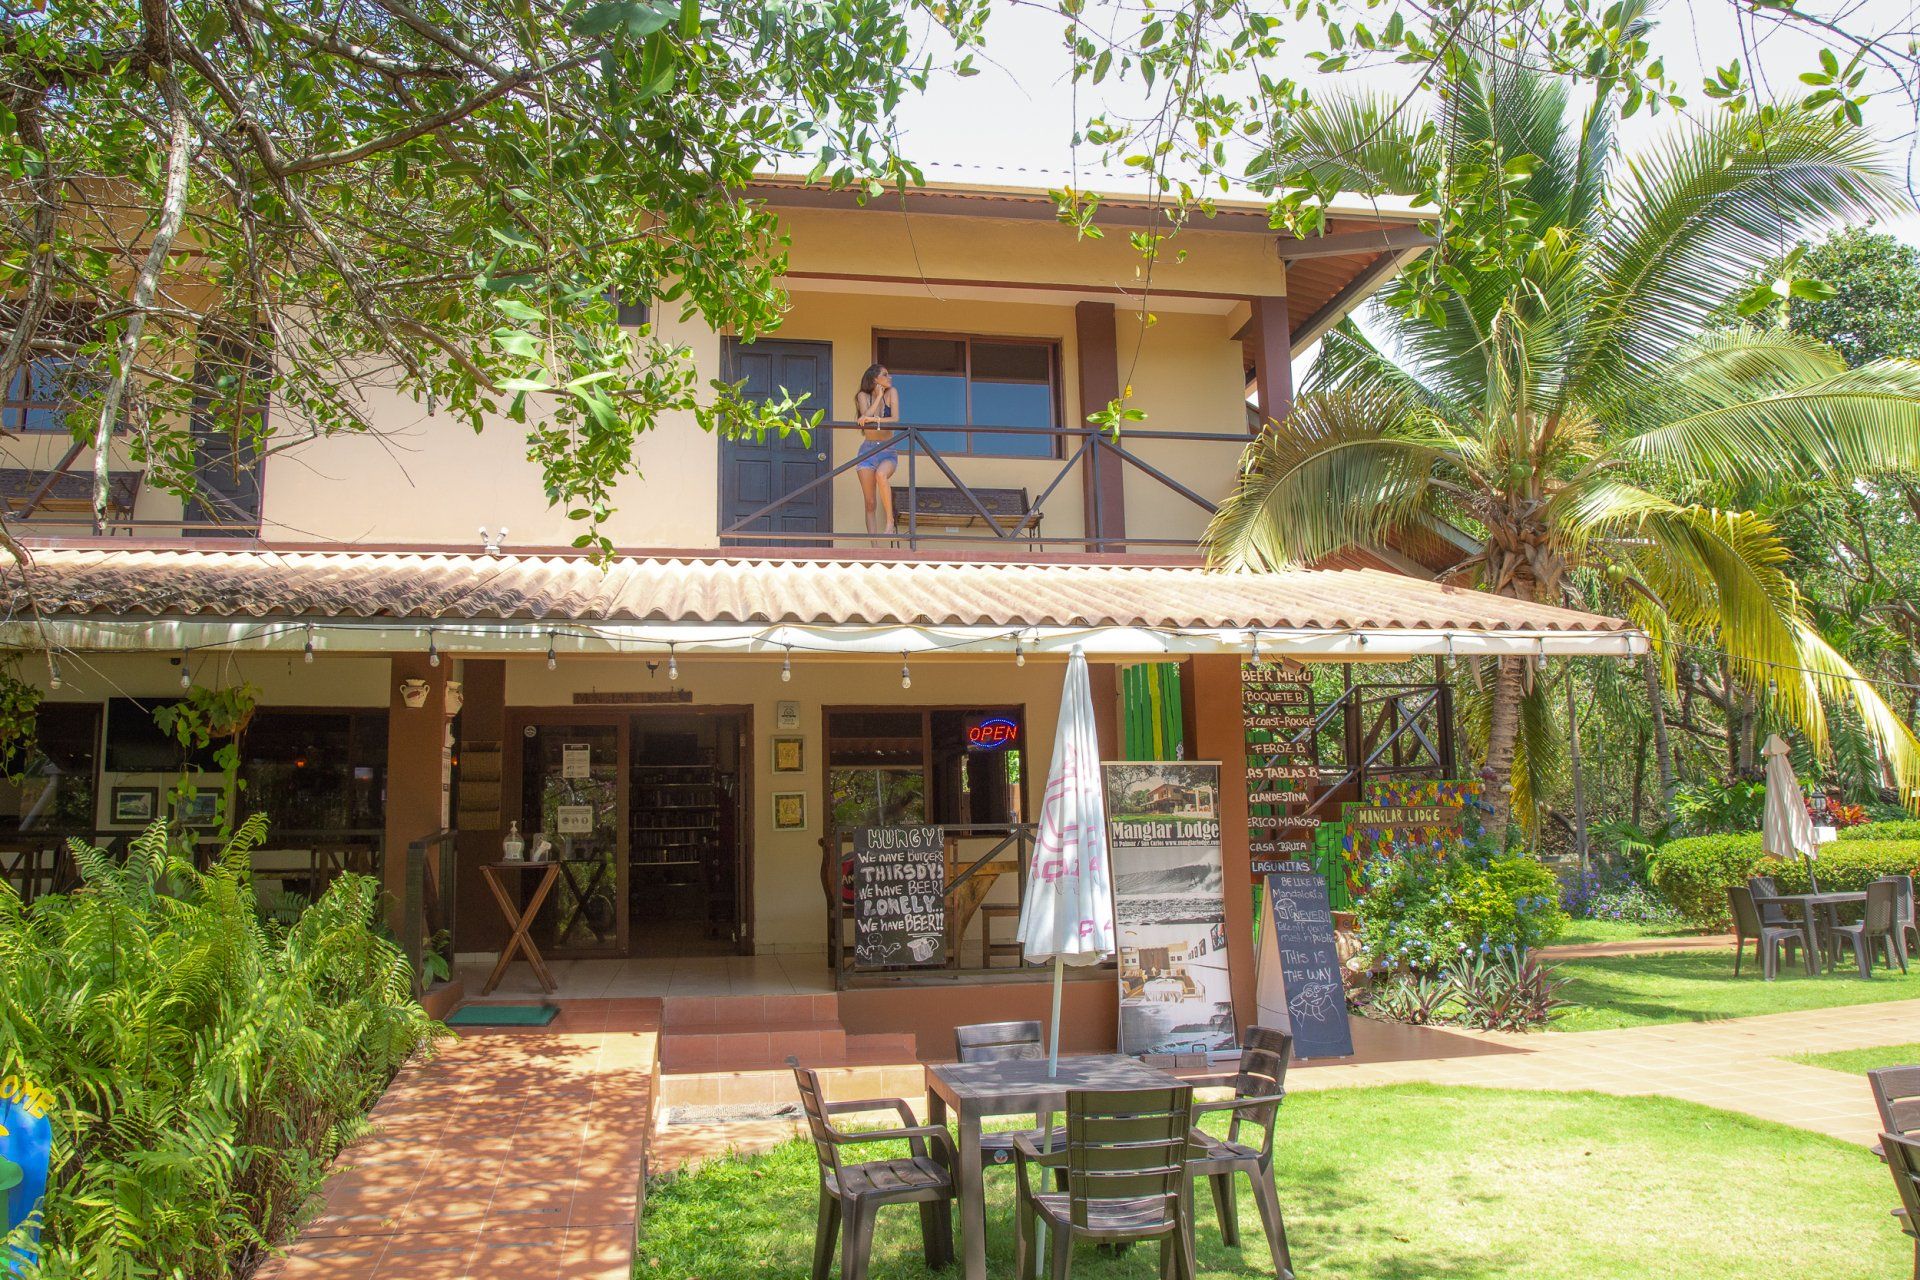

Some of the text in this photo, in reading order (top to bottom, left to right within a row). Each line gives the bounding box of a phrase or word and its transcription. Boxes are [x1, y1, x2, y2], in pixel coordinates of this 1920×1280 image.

[1241, 670, 1312, 682] BEER MENU
[1244, 690, 1293, 703] BOQUETE
[969, 725, 1017, 741] OPEN
[1251, 743, 1294, 754] FEROZ
[1245, 767, 1264, 779] AS
[1264, 767, 1306, 779] TABLAS
[1248, 791, 1309, 802] CLANDESTINA
[1278, 815, 1320, 827] MAÑOSO
[1359, 809, 1403, 824] MANGLAR
[1111, 820, 1220, 841] Manglar Lodge
[1249, 842, 1275, 852] CASA
[1251, 860, 1311, 872] LAGUNITAS
[1314, 950, 1328, 964] IS
[1283, 967, 1332, 985] THE WAY
